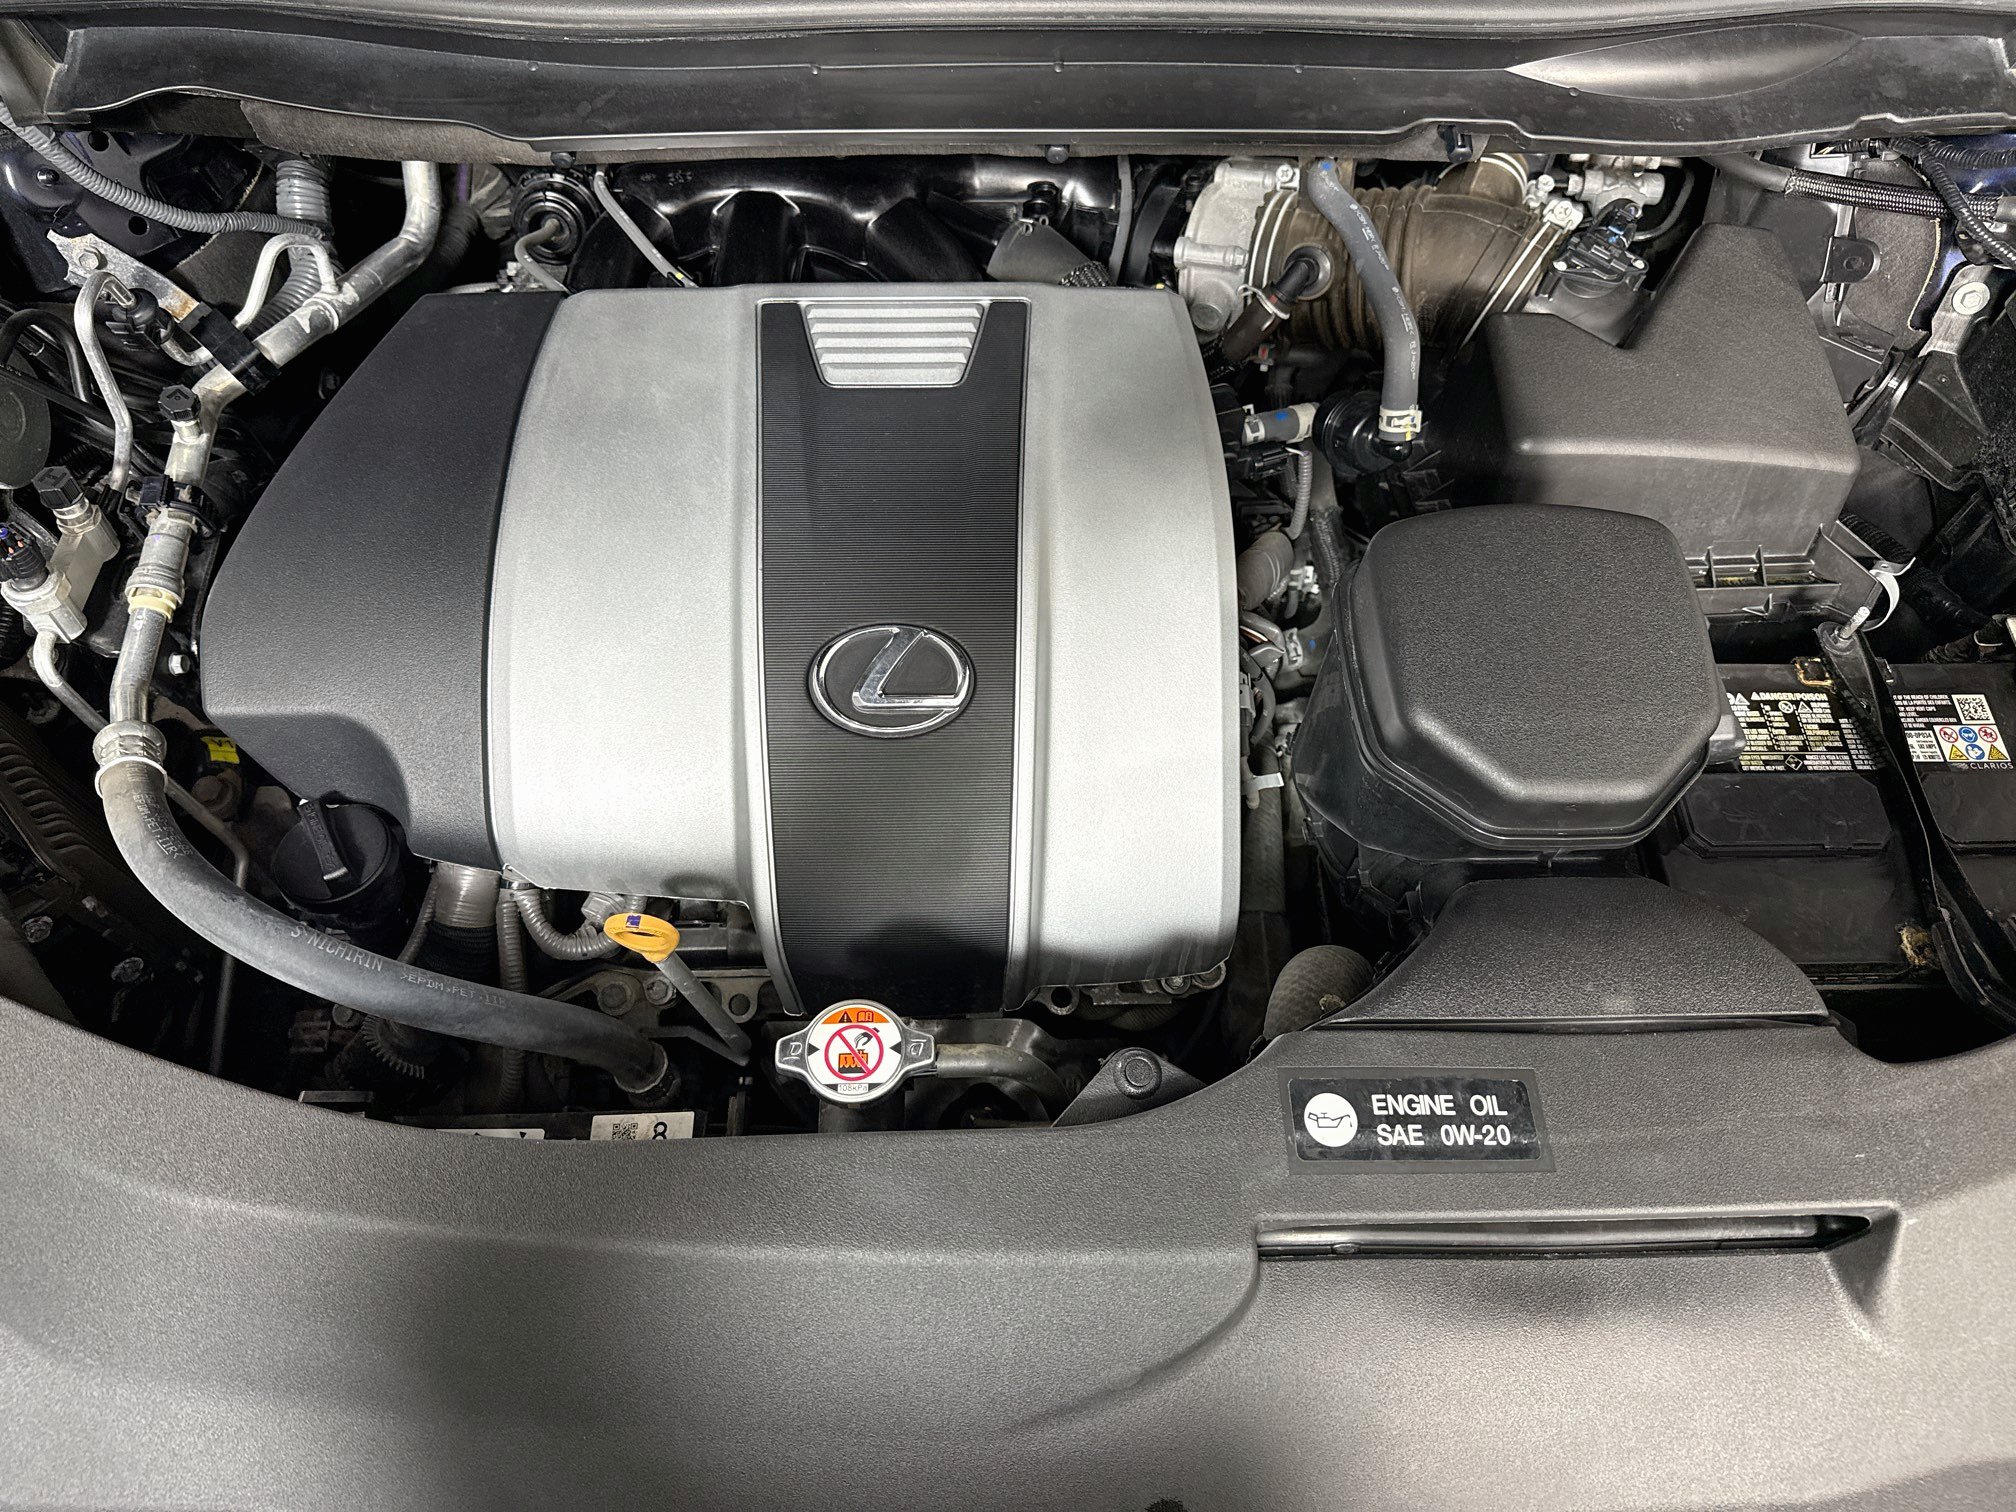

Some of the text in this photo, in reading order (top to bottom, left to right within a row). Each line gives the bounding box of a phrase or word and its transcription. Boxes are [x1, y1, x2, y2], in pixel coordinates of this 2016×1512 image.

[1759, 692, 1828, 701] DANGER/POISON
[307, 932, 382, 972] NICHIRIN
[1371, 1094, 1508, 1116] ENGINE OIL
[1377, 1124, 1511, 1146] SAE 0W-20
